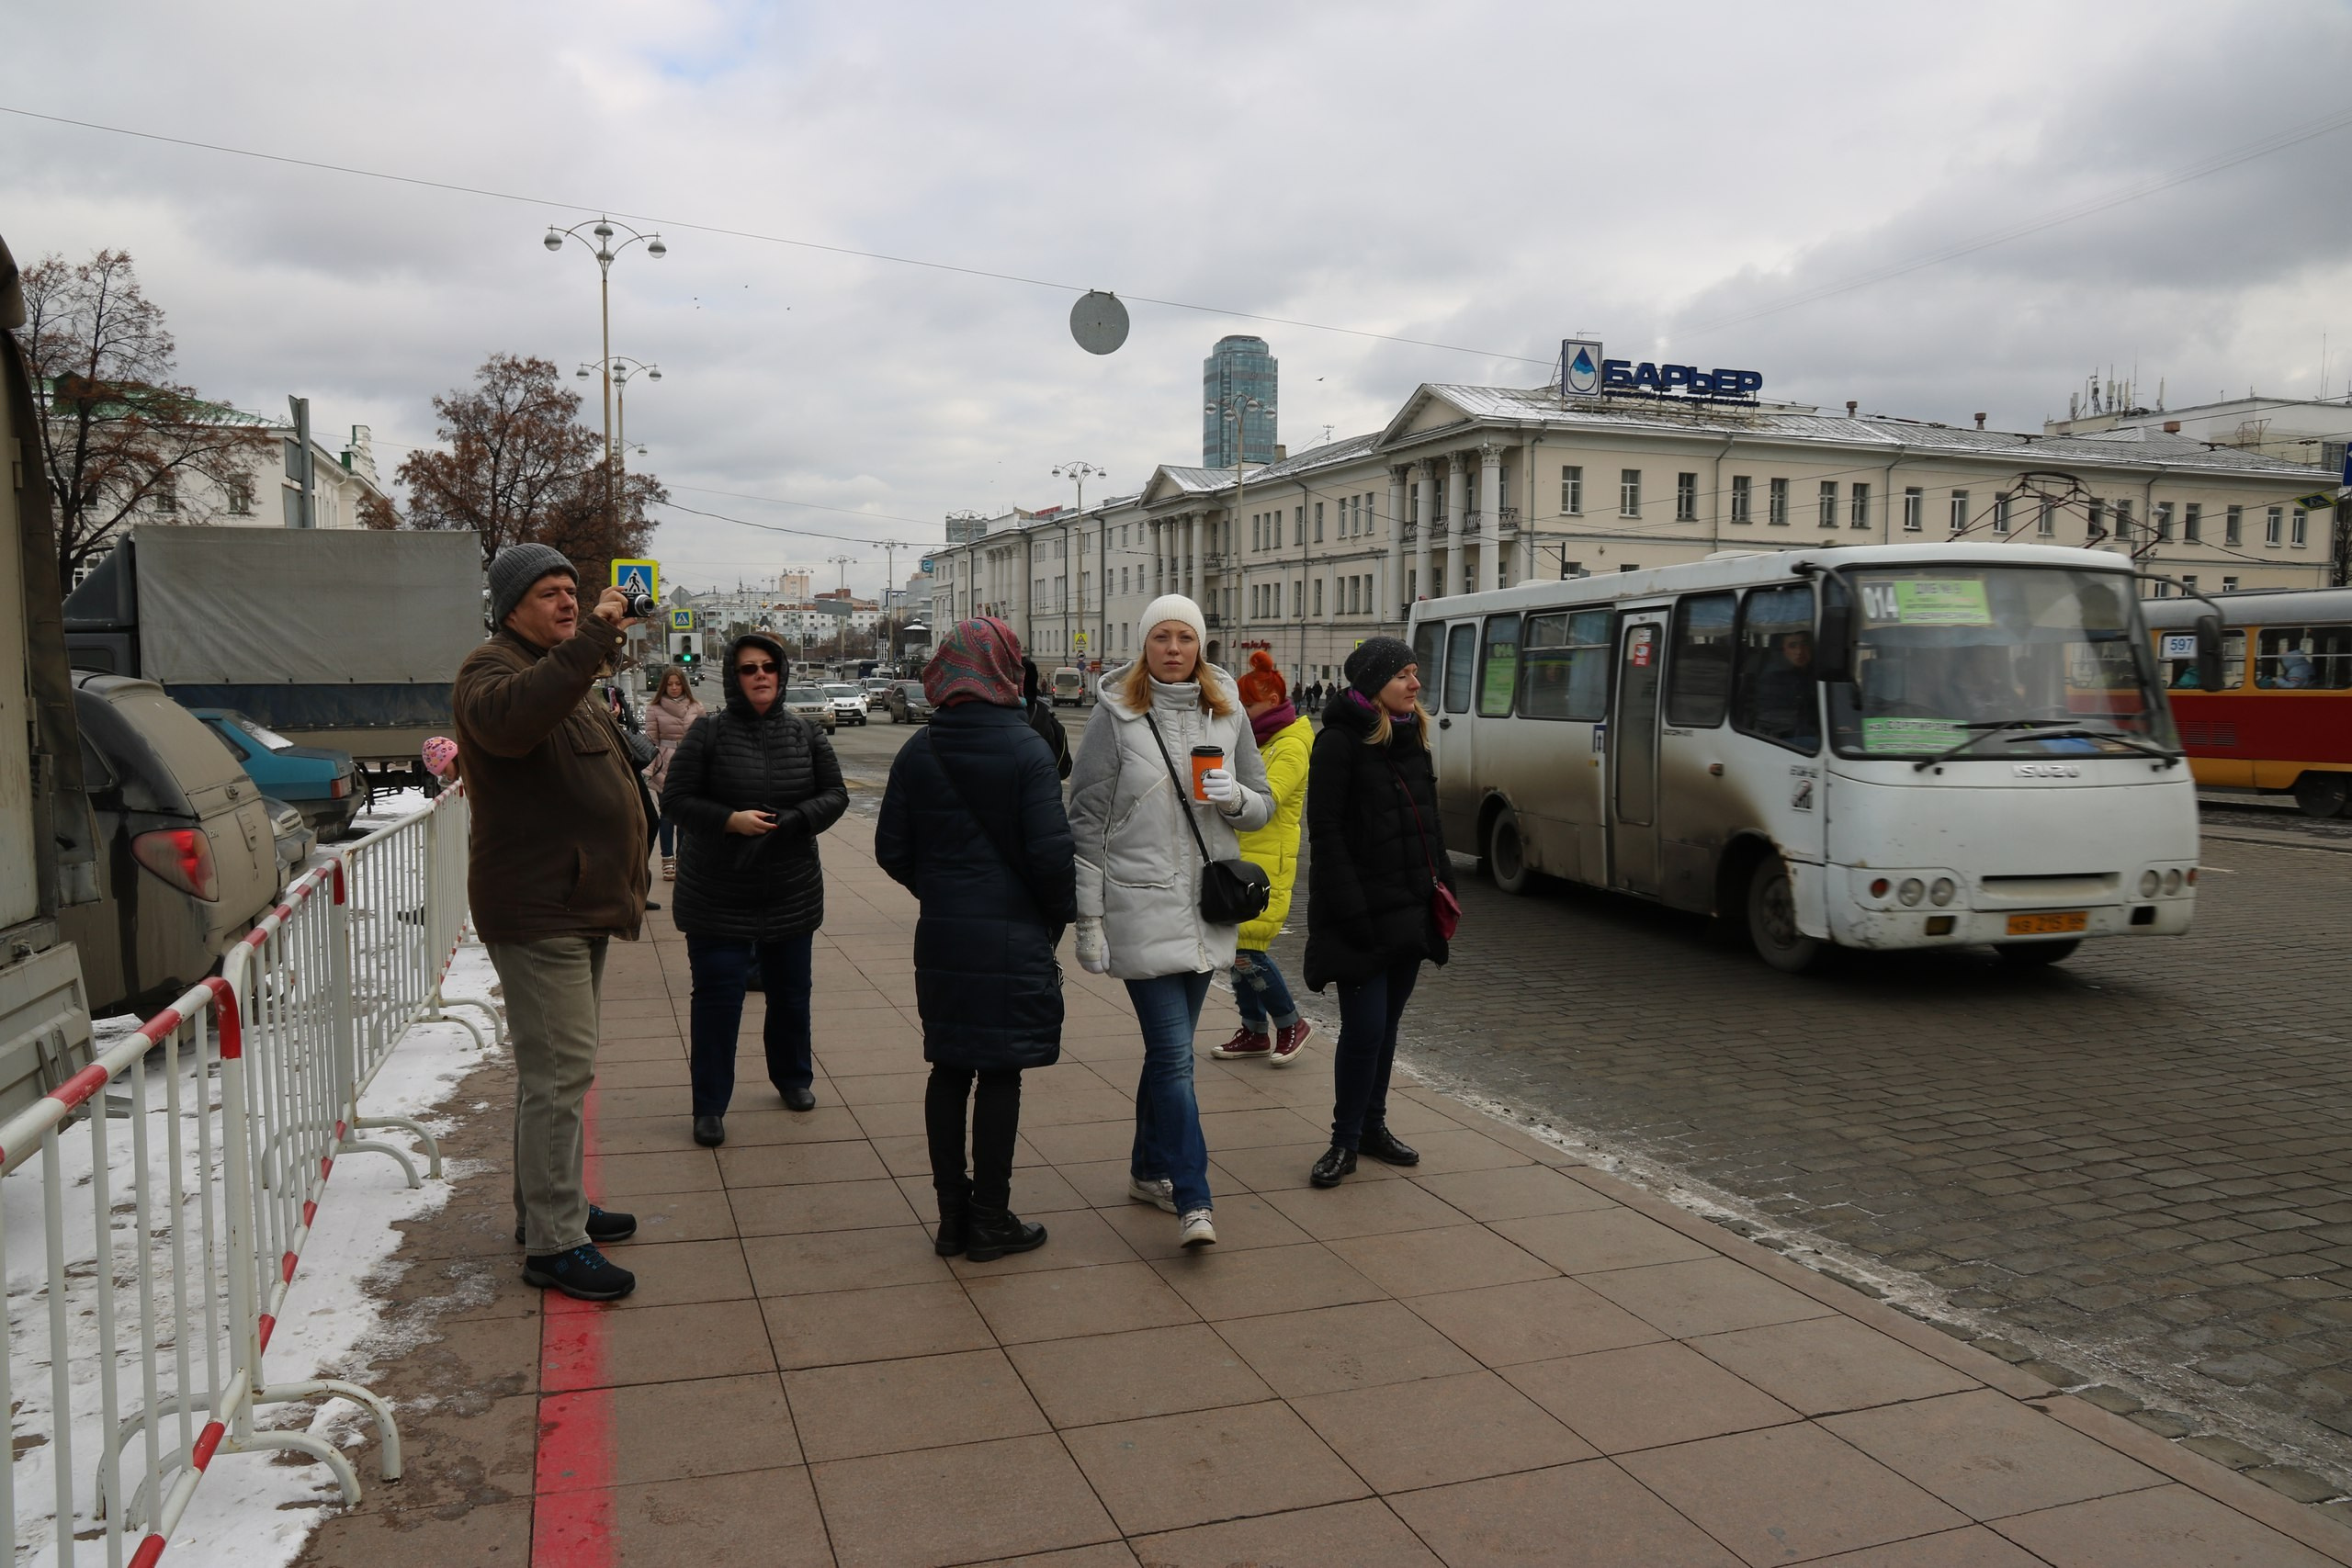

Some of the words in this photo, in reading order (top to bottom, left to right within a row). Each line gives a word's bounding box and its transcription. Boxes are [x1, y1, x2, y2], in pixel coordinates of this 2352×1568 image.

[1602, 359, 1762, 394] БАРЬЕР
[1861, 585, 1900, 619] 014
[2170, 638, 2194, 650] 597
[2013, 764, 2081, 778] ISUZU
